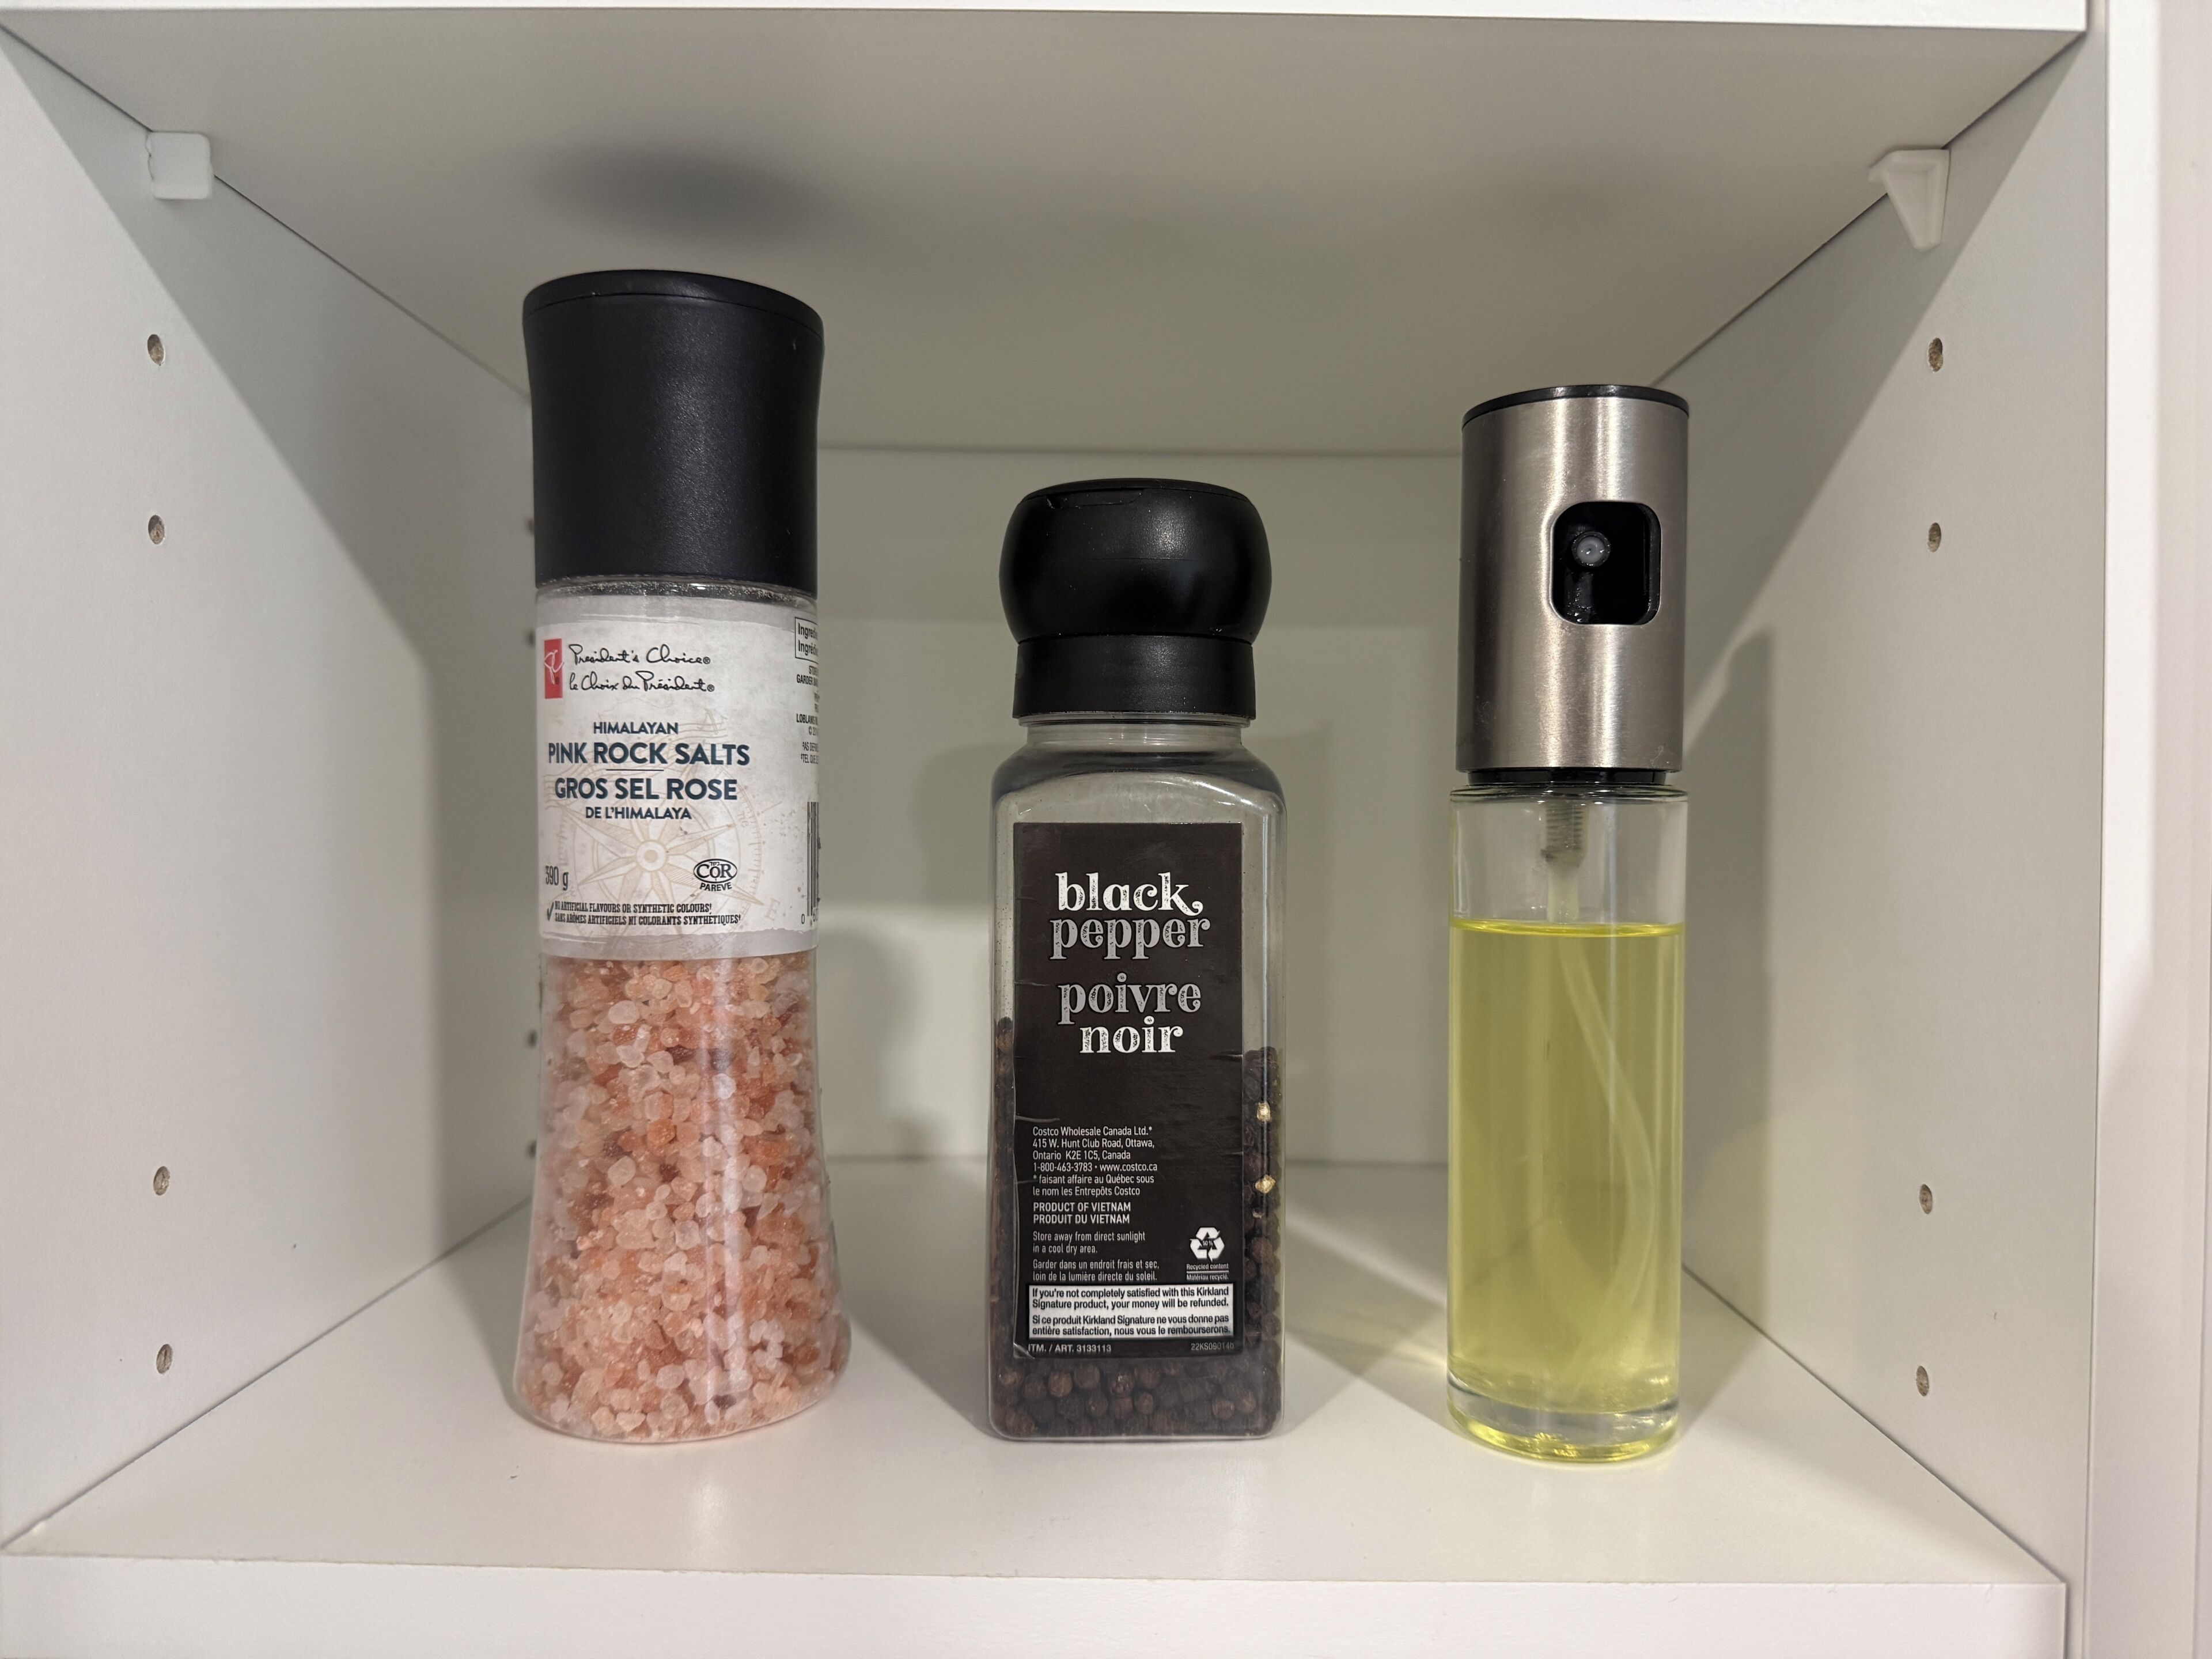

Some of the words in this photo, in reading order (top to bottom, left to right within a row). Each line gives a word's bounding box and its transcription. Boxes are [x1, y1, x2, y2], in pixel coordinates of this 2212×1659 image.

[568, 643, 639, 664] President's
[569, 673, 578, 691] le
[581, 672, 619, 691] Choix
[622, 672, 642, 691] du
[797, 674, 813, 685] GARDER
[593, 722, 679, 734] HIMALAYAN
[548, 742, 586, 764] PINK
[594, 743, 668, 764] ROCK
[675, 744, 749, 766] SALTS
[555, 778, 608, 799] GROS
[615, 778, 659, 800] SEL
[667, 779, 737, 800] ROSE
[585, 806, 601, 819] DE
[605, 806, 692, 820] L'HIMALAYA
[545, 865, 559, 885] 390
[563, 869, 570, 890] g
[699, 882, 733, 892] PAREVE
[1055, 872, 1203, 916] black
[561, 902, 588, 912] ARTIFICIAL
[589, 903, 621, 913] FLAVOURS
[622, 903, 631, 913] OR
[633, 903, 675, 913] SYNTHETIC
[555, 912, 566, 922] SANS
[566, 912, 586, 924] ARÔMES
[588, 915, 627, 925] ARTIFICIELS
[628, 915, 637, 925] NI
[638, 915, 681, 926] COLORANTS
[1050, 919, 1210, 960] pepper
[1058, 972, 1200, 1025] poivre
[1080, 1016, 1183, 1053] noir
[1033, 1127, 1059, 1135] Costco
[1061, 1126, 1101, 1135] Wholesale
[1103, 1126, 1131, 1135] Canada
[1033, 1139, 1047, 1147] 415
[1049, 1139, 1059, 1147] W.
[1062, 1139, 1080, 1147] Hunt
[1082, 1138, 1099, 1147] Club
[1102, 1138, 1123, 1148] Road,
[1126, 1138, 1154, 1148] Ottawa,
[1033, 1150, 1061, 1160] Ontario
[1066, 1150, 1081, 1160] K2E
[1084, 1150, 1100, 1161] 1C5,
[1103, 1150, 1130, 1159] Canada
[1034, 1162, 1092, 1172] 1-800-463-3783
[1100, 1163, 1157, 1171] www.costco.ca
[1039, 1175, 1065, 1183] faisant
[1067, 1175, 1092, 1183] affaire
[1106, 1174, 1134, 1183] Québec
[1033, 1186, 1040, 1195] le
[1062, 1187, 1072, 1195] les
[1075, 1186, 1112, 1198] Entrepôts
[1115, 1186, 1140, 1195] Costco
[1034, 1202, 1075, 1211] PRODUCT
[1078, 1203, 1089, 1211] OF
[1092, 1202, 1130, 1211] VIETNAM
[1033, 1214, 1072, 1224] PRODUIT
[1075, 1214, 1087, 1224] DU
[1090, 1214, 1129, 1224] VIETNAM
[1033, 1231, 1051, 1241] Store
[1055, 1234, 1072, 1244] away
[1075, 1232, 1091, 1241] from
[1094, 1232, 1114, 1241] direct
[1117, 1231, 1145, 1243] sunlight
[1033, 1244, 1039, 1252] in
[1049, 1243, 1063, 1253] cool
[1066, 1241, 1077, 1255] dry
[1033, 1259, 1057, 1269] Garder
[1059, 1260, 1076, 1269] dans
[1090, 1259, 1115, 1269] endroit
[1118, 1259, 1133, 1268] frais
[1136, 1260, 1142, 1268] et
[1033, 1271, 1046, 1281] loin
[1049, 1271, 1056, 1281] de
[1060, 1271, 1066, 1281] la
[1069, 1272, 1095, 1281] lumière
[1099, 1271, 1122, 1281] directe
[1125, 1271, 1133, 1281] du
[1137, 1271, 1157, 1281] soleil.
[1033, 1288, 1037, 1297] If
[1040, 1289, 1064, 1299] you're
[1066, 1289, 1079, 1297] not
[1081, 1289, 1125, 1299] completely
[1127, 1288, 1160, 1297] satisfied
[1162, 1288, 1179, 1297] with
[1181, 1287, 1195, 1296] this
[1197, 1286, 1229, 1296] Kirkland
[1033, 1299, 1071, 1310] Signature
[1074, 1300, 1108, 1310] product,
[1112, 1301, 1130, 1310] your
[1132, 1301, 1159, 1309] money
[1162, 1298, 1175, 1308] will
[1178, 1298, 1187, 1307] be
[1190, 1297, 1228, 1307] refunded.
[1033, 1315, 1040, 1324] Si
[1053, 1316, 1081, 1326] produit
[1083, 1316, 1115, 1324] Kirkland
[1118, 1315, 1155, 1326] Signature
[1188, 1315, 1213, 1323] donne
[1214, 1316, 1229, 1324] pas
[1032, 1326, 1060, 1335] entière
[1063, 1327, 1111, 1336] satisfaction,
[1158, 1326, 1165, 1335] le
[1166, 1325, 1232, 1335] rembourserons.
